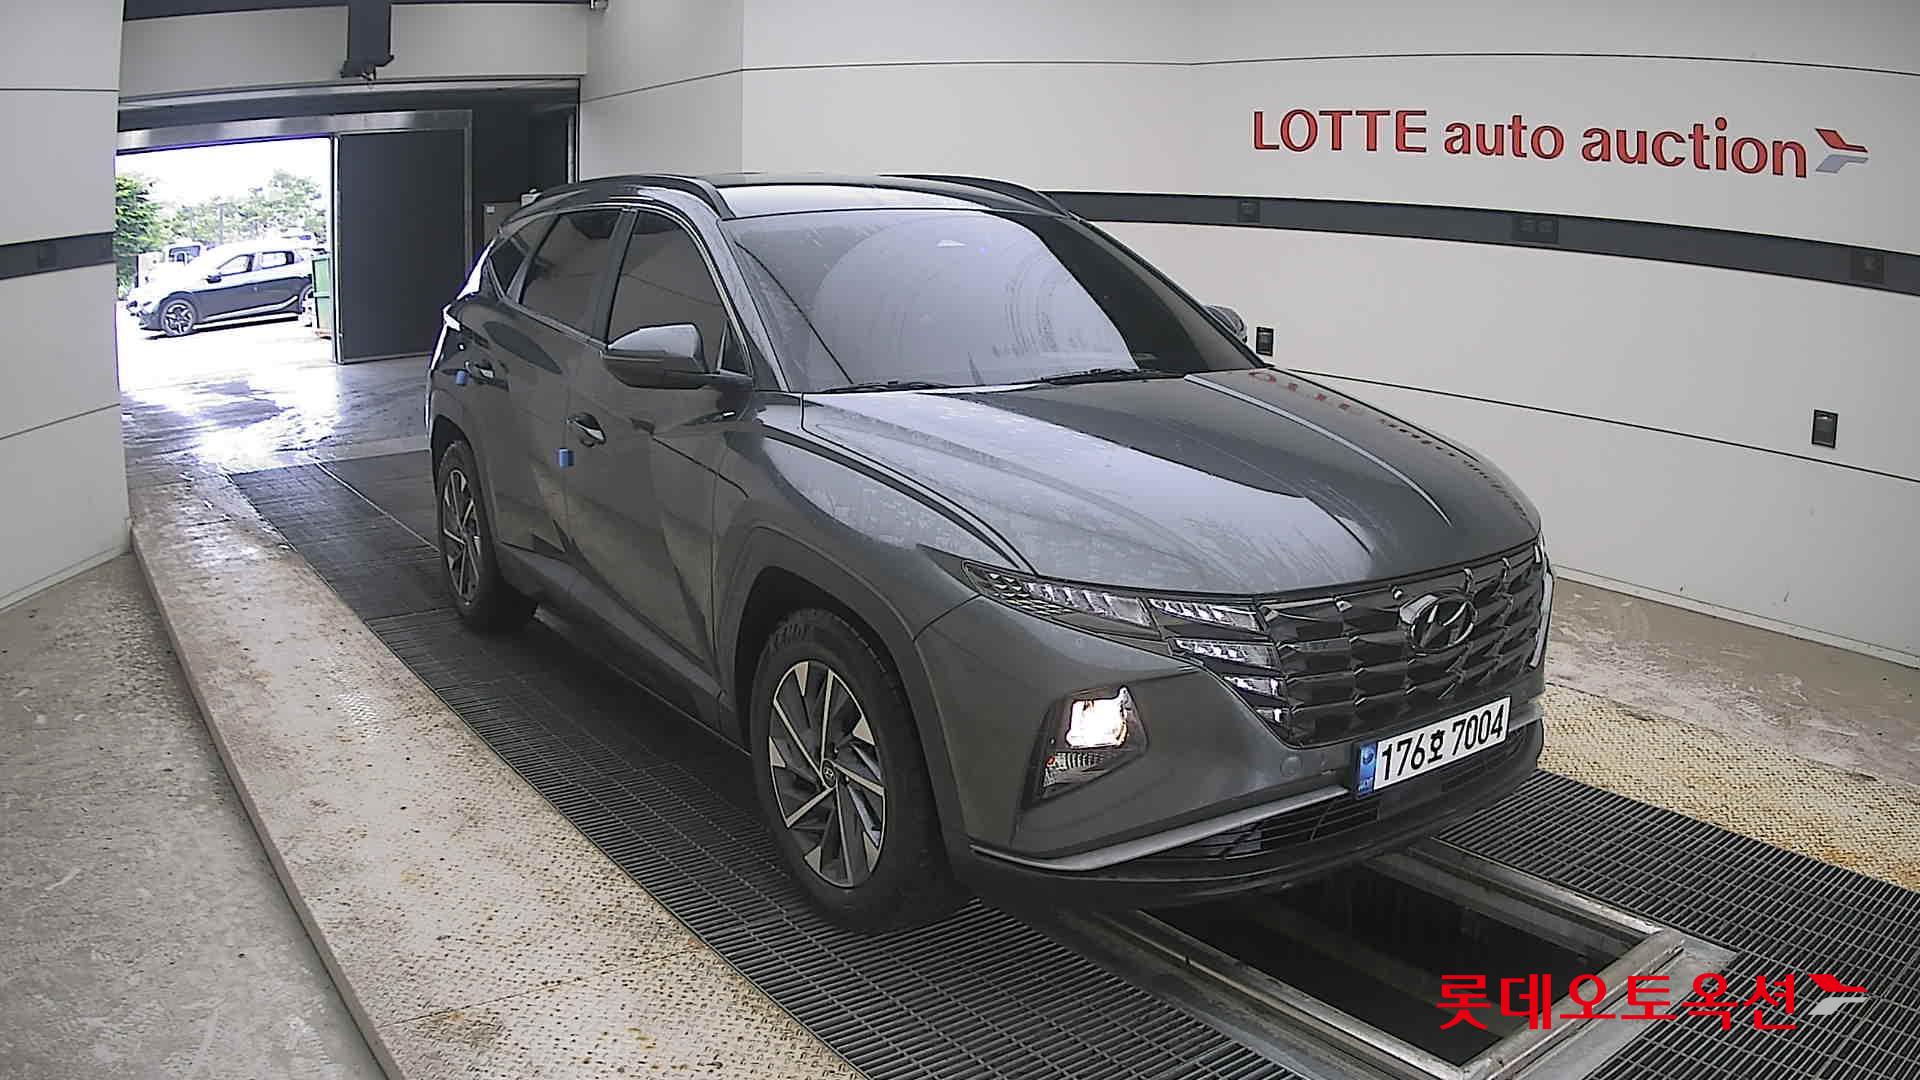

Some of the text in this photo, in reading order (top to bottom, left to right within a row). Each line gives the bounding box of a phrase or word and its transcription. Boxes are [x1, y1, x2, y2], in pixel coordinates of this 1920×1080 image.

[1253, 108, 1808, 178] LOTTE auto auction
[1382, 704, 1504, 781] 176호 7004
